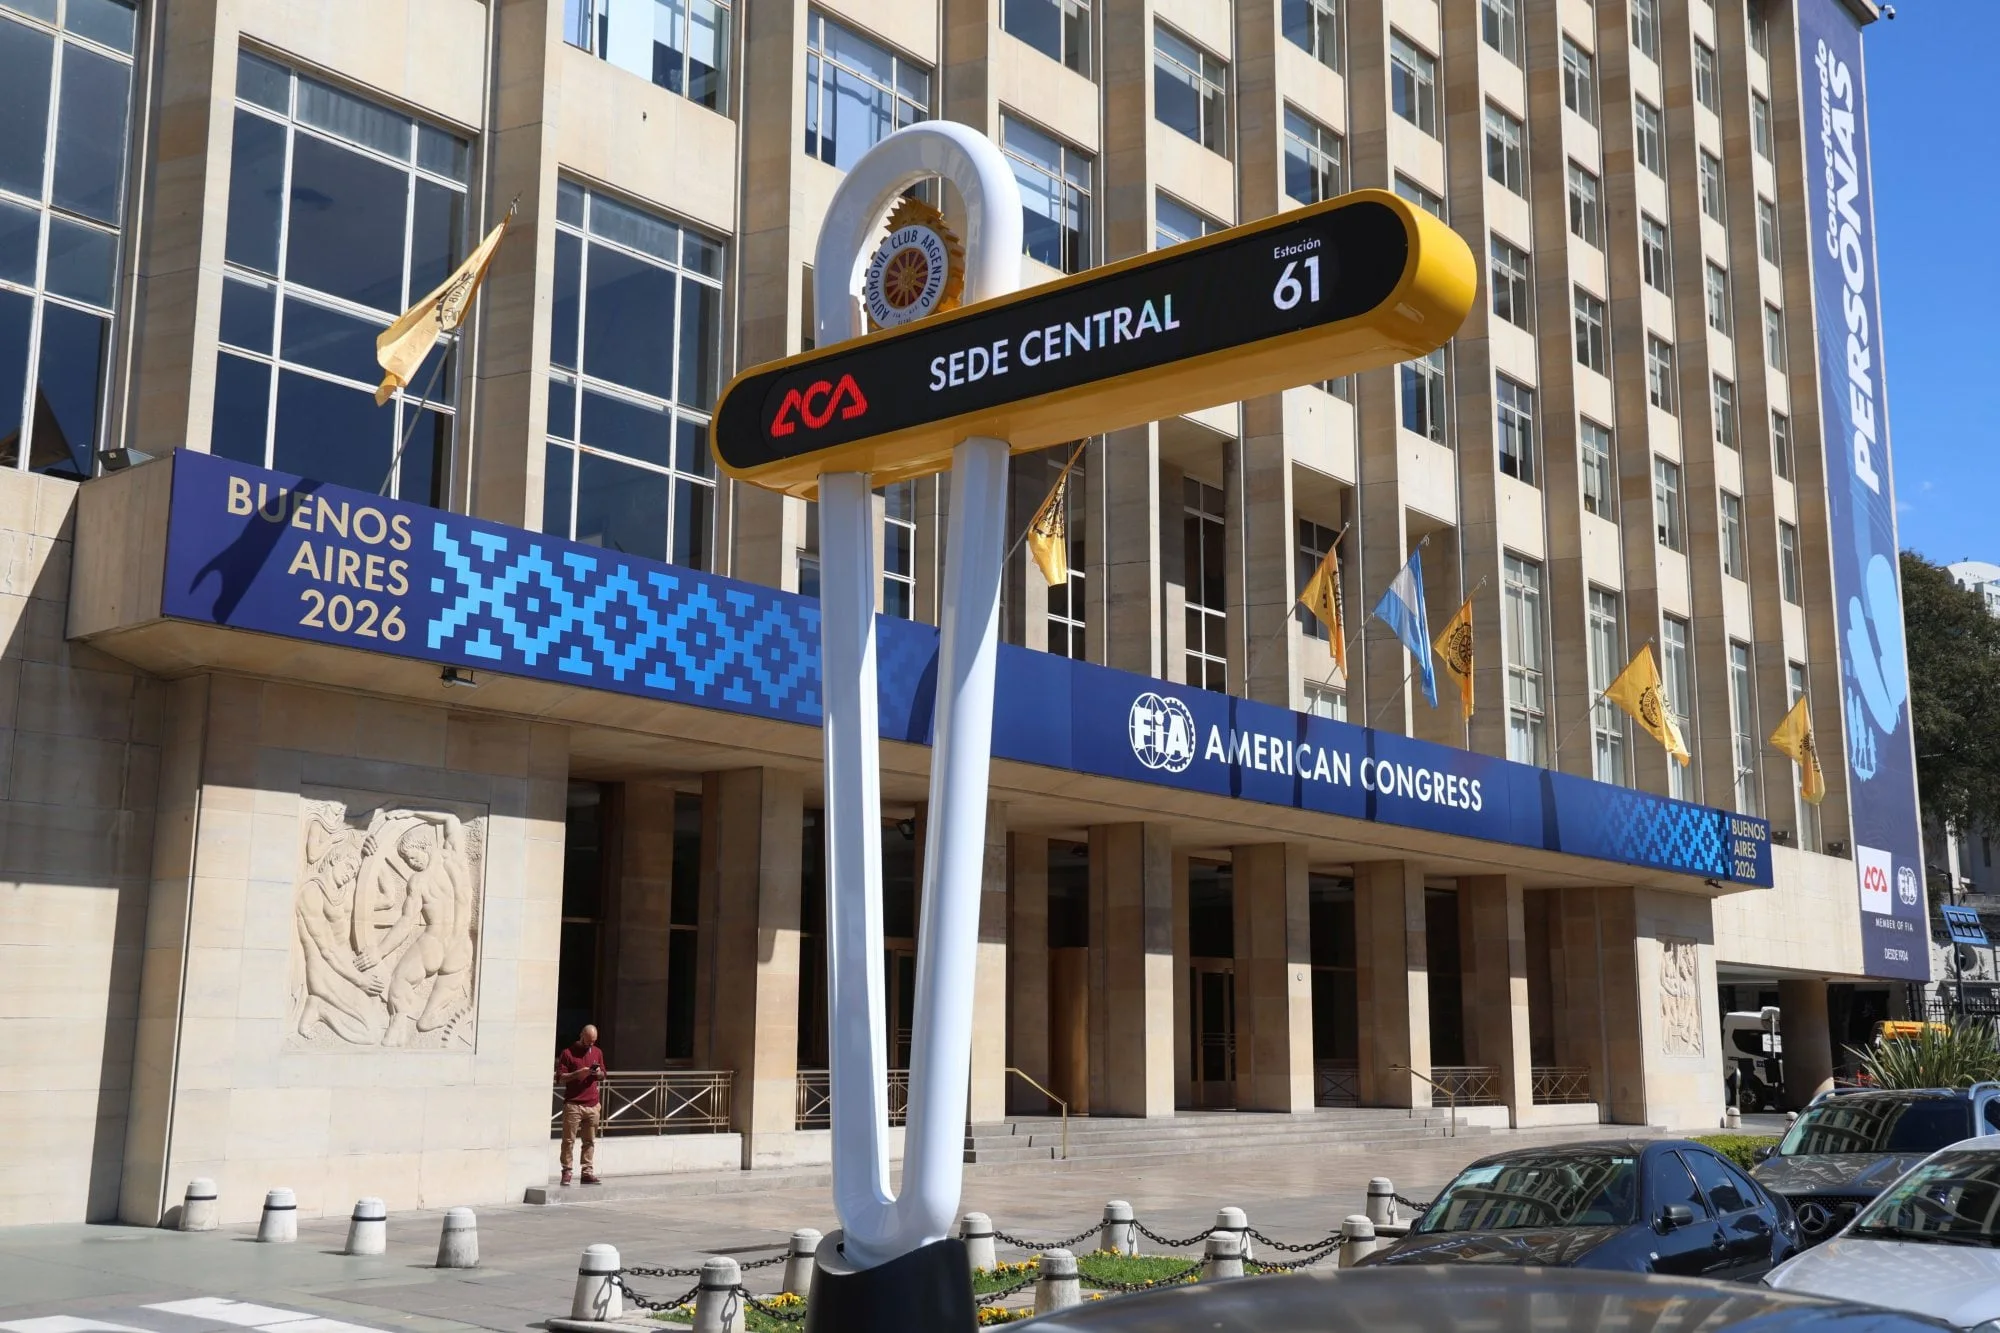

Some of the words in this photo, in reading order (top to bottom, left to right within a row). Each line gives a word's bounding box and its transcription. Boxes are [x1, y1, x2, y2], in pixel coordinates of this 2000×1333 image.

[1815, 38, 1839, 259] Conectando
[869, 251, 890, 321] AUTOMOVIL
[891, 229, 918, 250] CLUB
[920, 234, 942, 308] ARGENTINO
[1273, 238, 1321, 259] Estación
[1828, 48, 1880, 495] PERSONAS
[1273, 255, 1320, 311] 61
[929, 338, 1009, 392] SEDE
[1019, 294, 1181, 367] CENTRAL
[770, 373, 868, 438] ACA
[227, 476, 412, 551] BUENOS
[288, 541, 410, 596] AIRES
[299, 588, 406, 642] 2026
[1204, 724, 1352, 787] AMERICAN
[1360, 756, 1483, 812] CONGRESS
[1731, 818, 1766, 841] BUENOS
[1733, 839, 1757, 859] AIRES
[1735, 859, 1756, 879] 2026
[1875, 916, 1896, 929] MEMBER
[1896, 920, 1904, 930] OF
[1904, 921, 1914, 932] FIA
